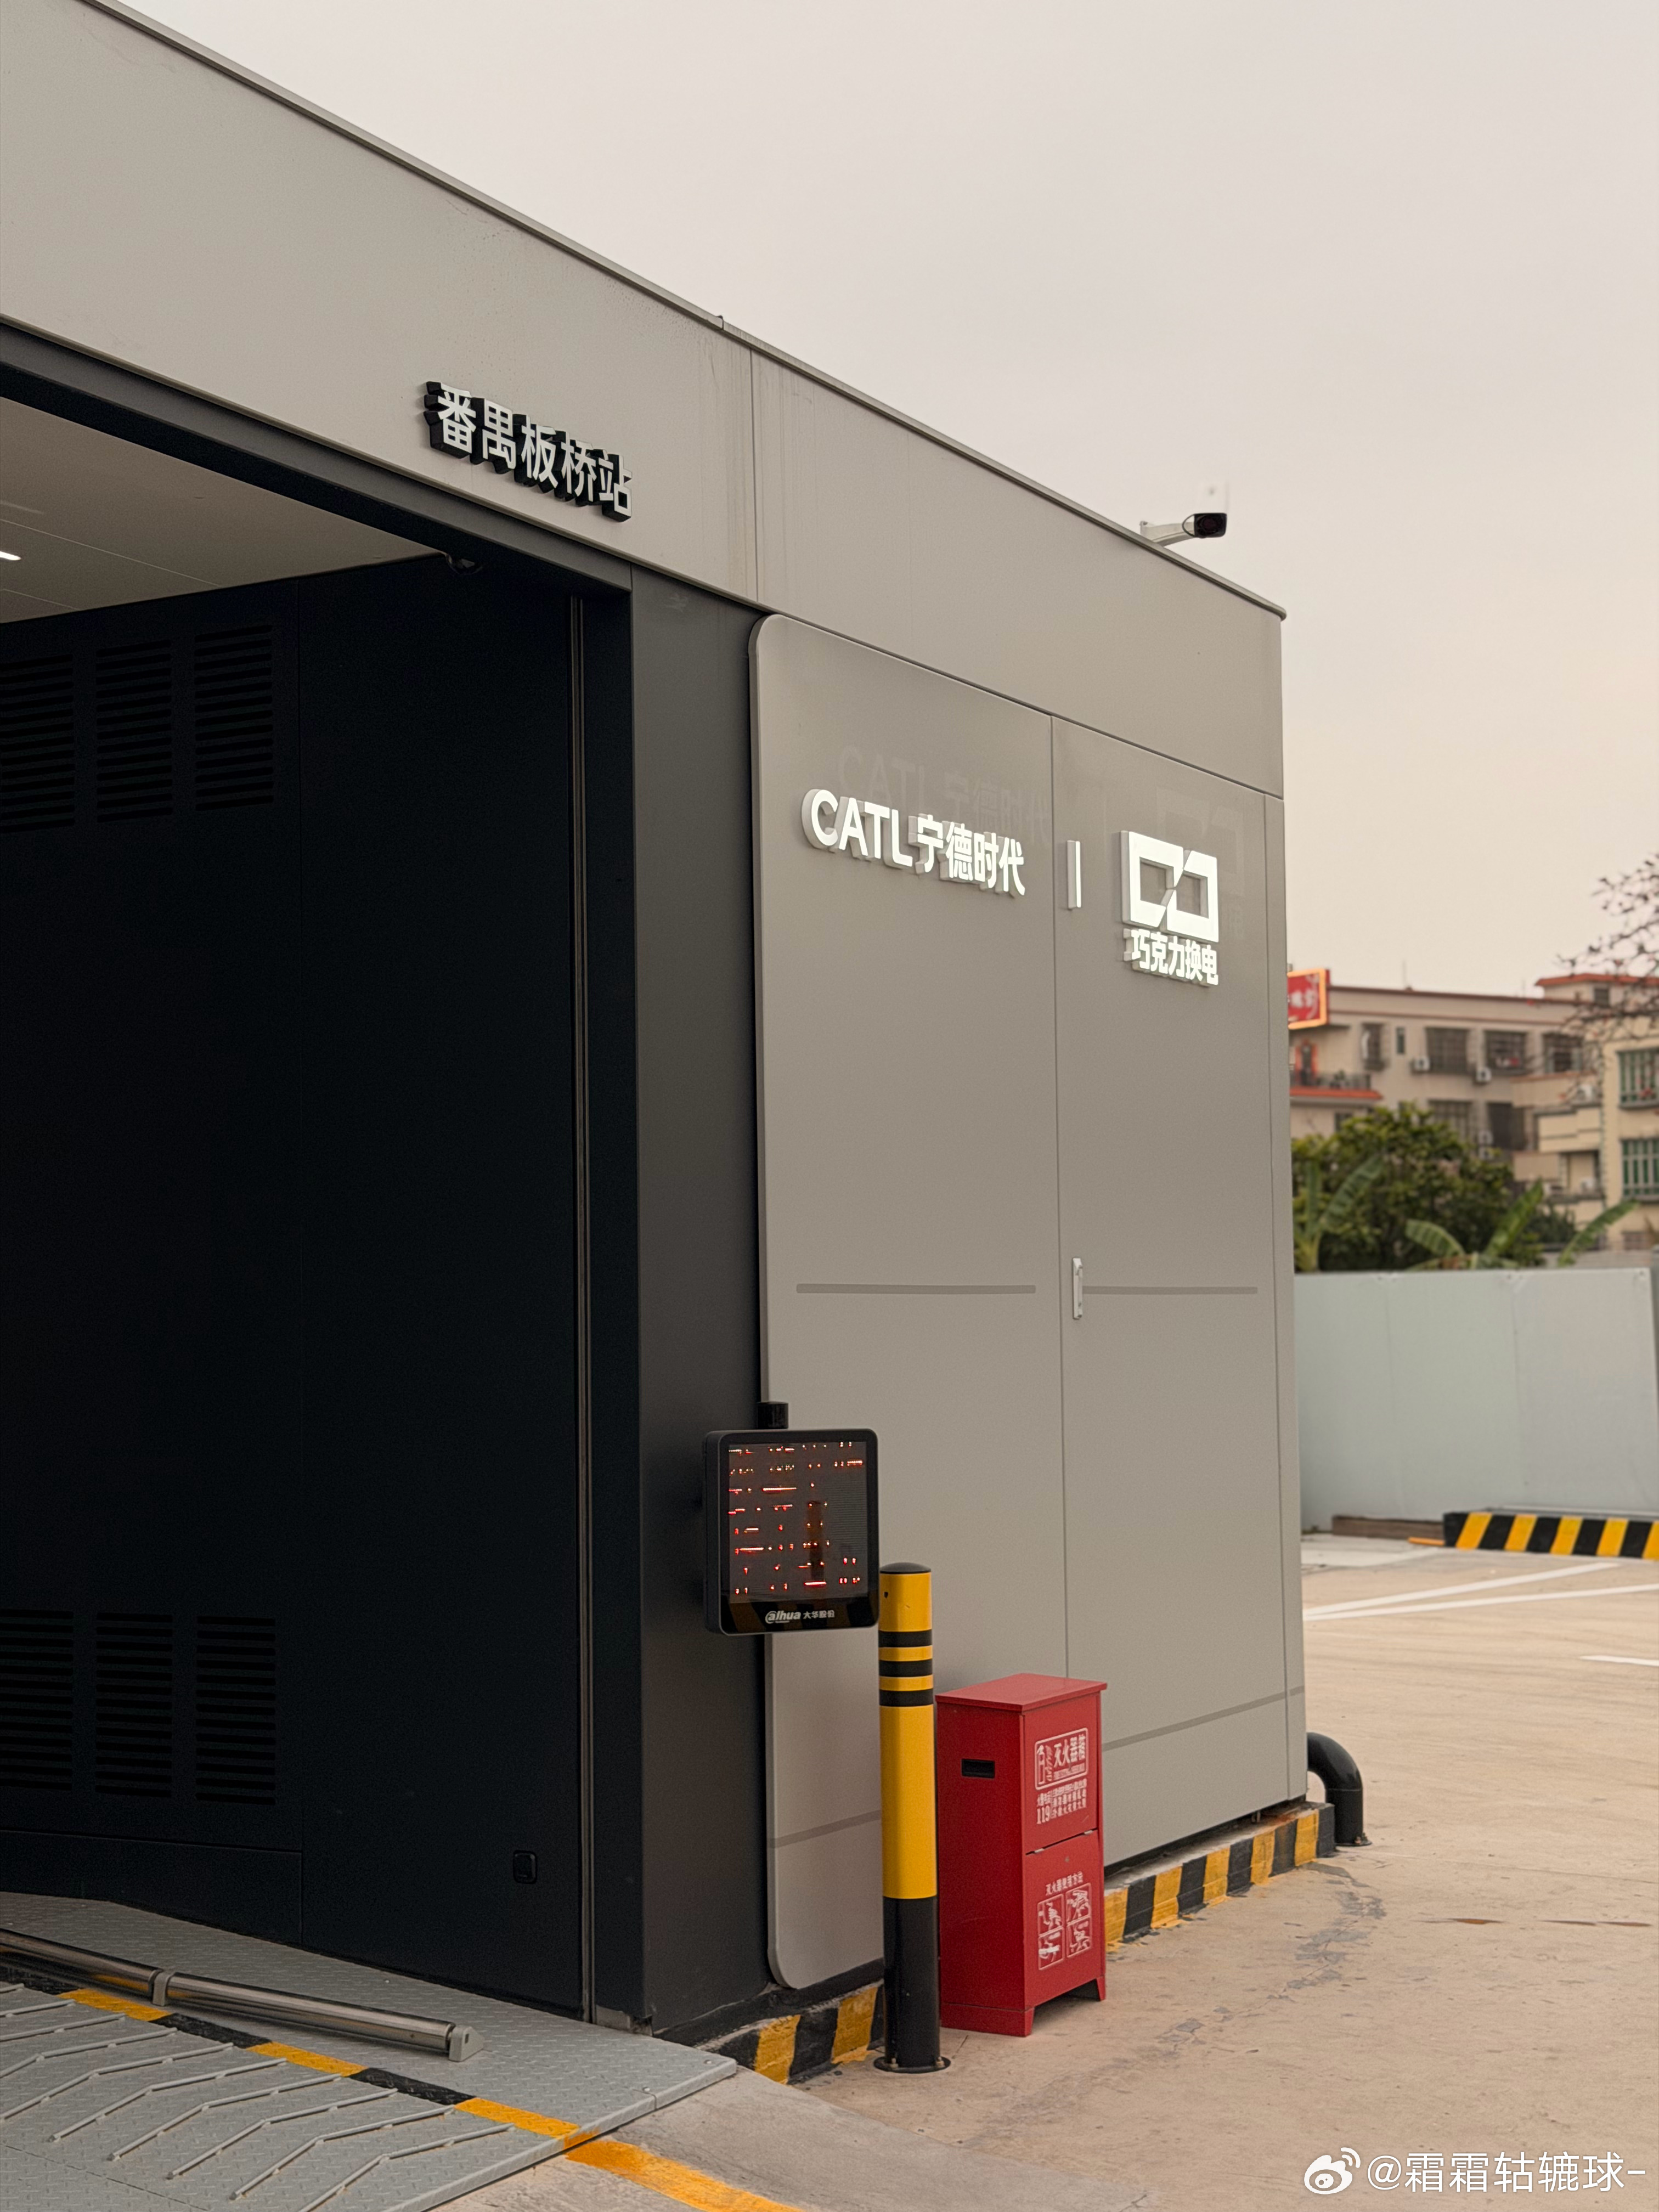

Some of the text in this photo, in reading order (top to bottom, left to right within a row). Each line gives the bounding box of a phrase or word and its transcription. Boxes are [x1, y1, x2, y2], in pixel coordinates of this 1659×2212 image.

[433, 382, 633, 519] 番禺板桥站
[1127, 928, 1218, 986] 巧克力换电
[1036, 1805, 1050, 1824] 119
